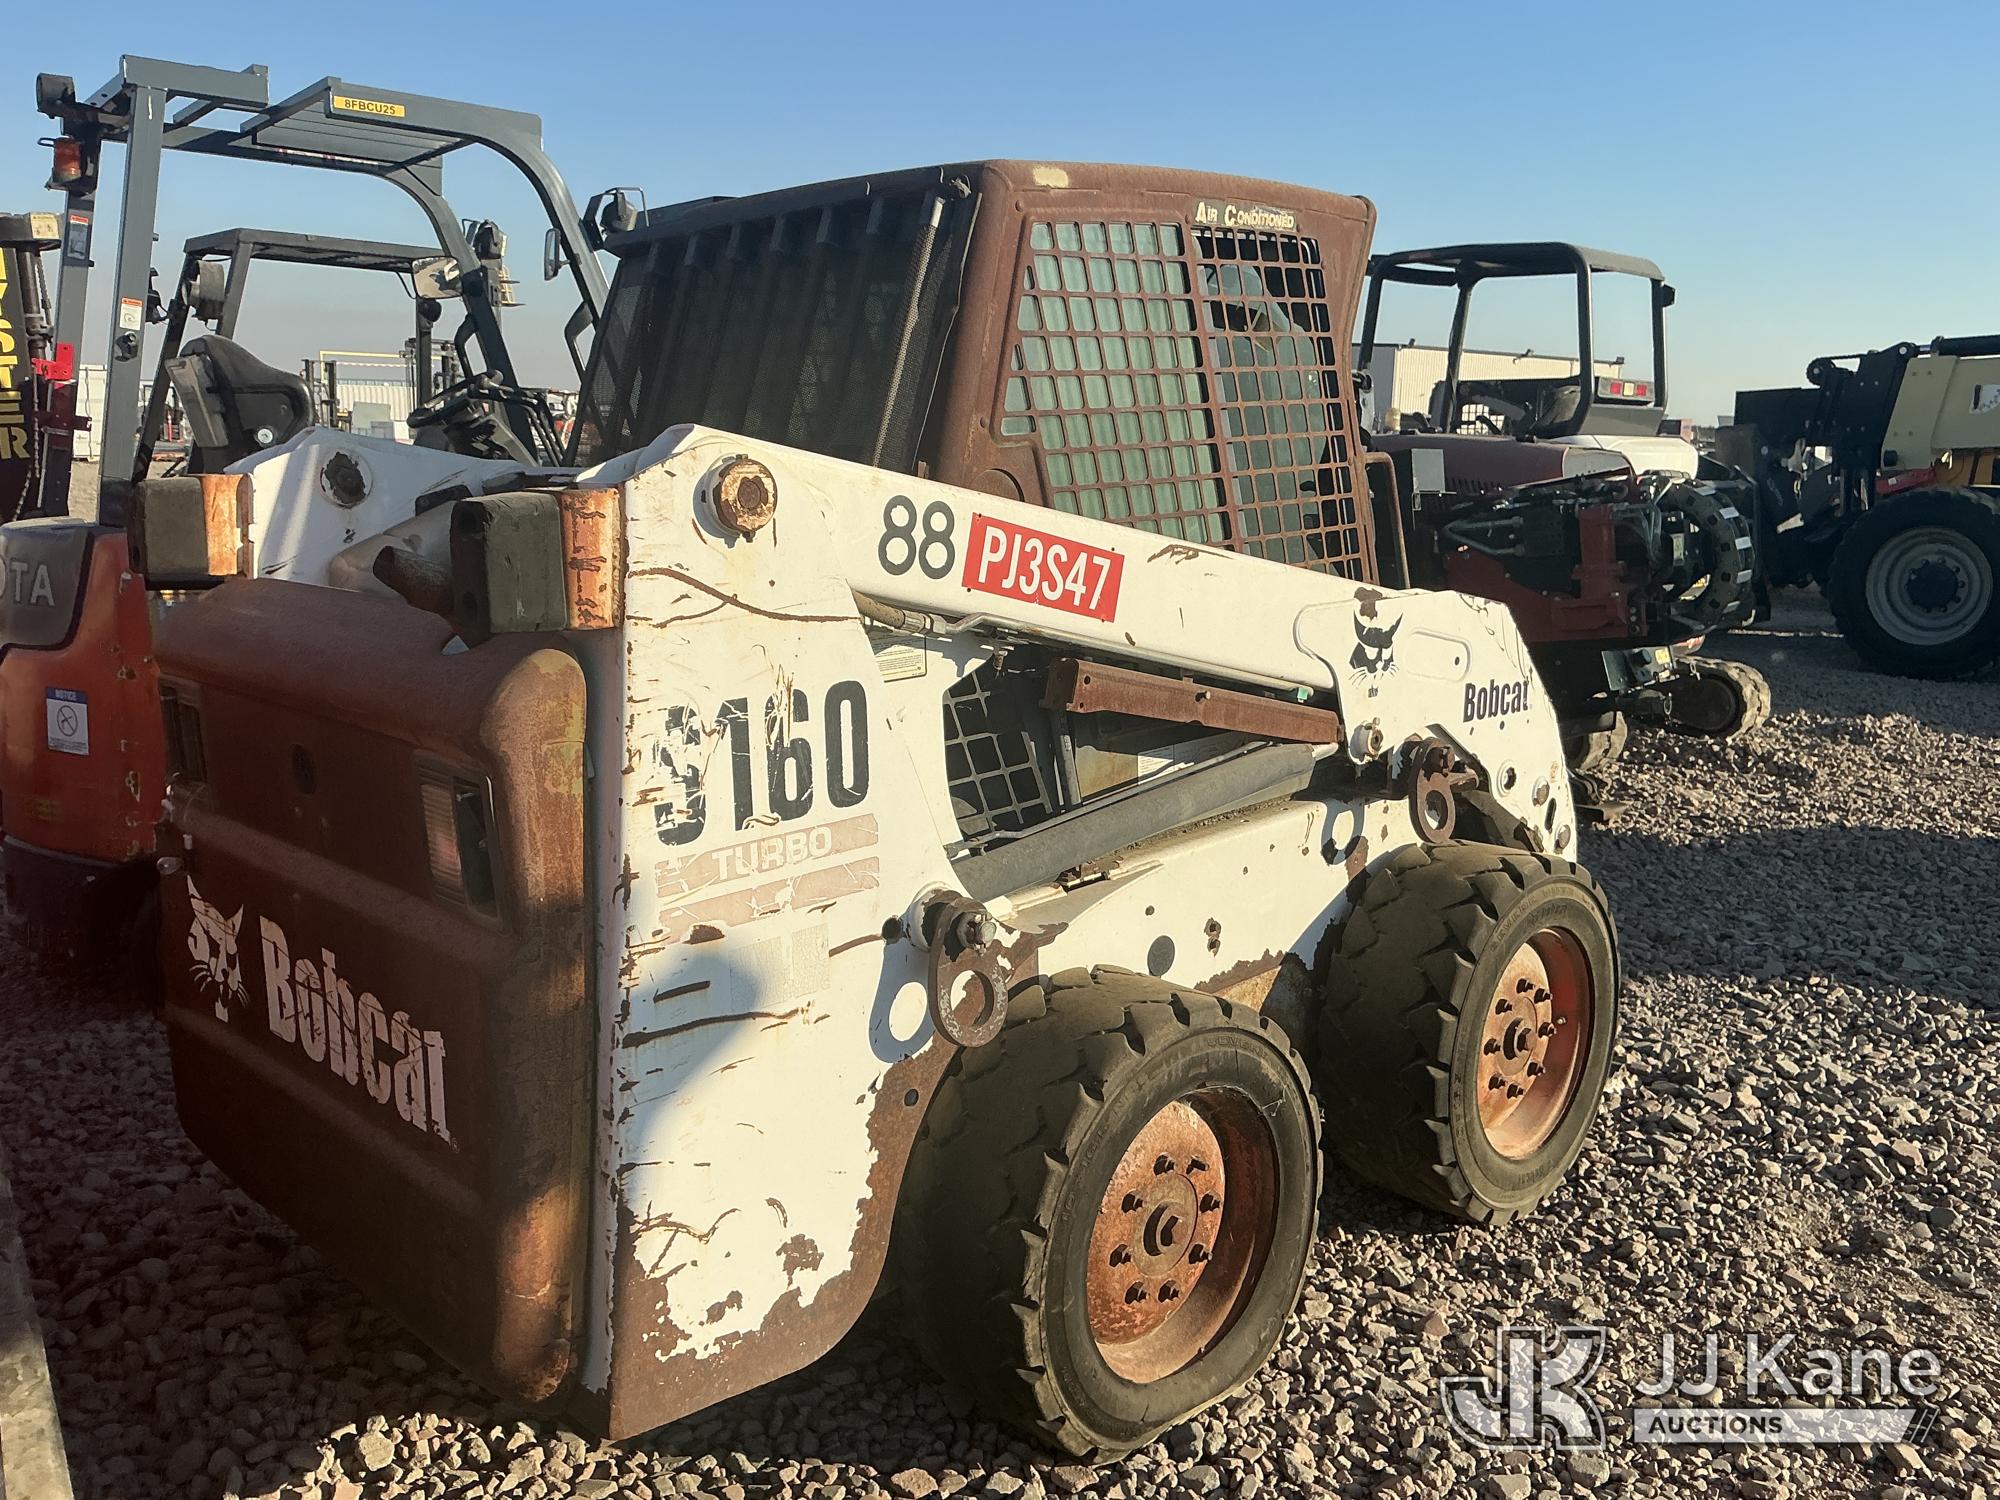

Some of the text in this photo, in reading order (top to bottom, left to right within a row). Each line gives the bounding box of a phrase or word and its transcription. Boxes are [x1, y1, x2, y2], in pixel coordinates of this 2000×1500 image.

[344, 99, 396, 115] 8FBCU25
[878, 494, 956, 580] 88
[977, 525, 1111, 611] PJ3S47
[1463, 679, 1530, 723] Bobcat
[711, 825, 832, 881] TURBO
[260, 915, 452, 1146] Bobcat
